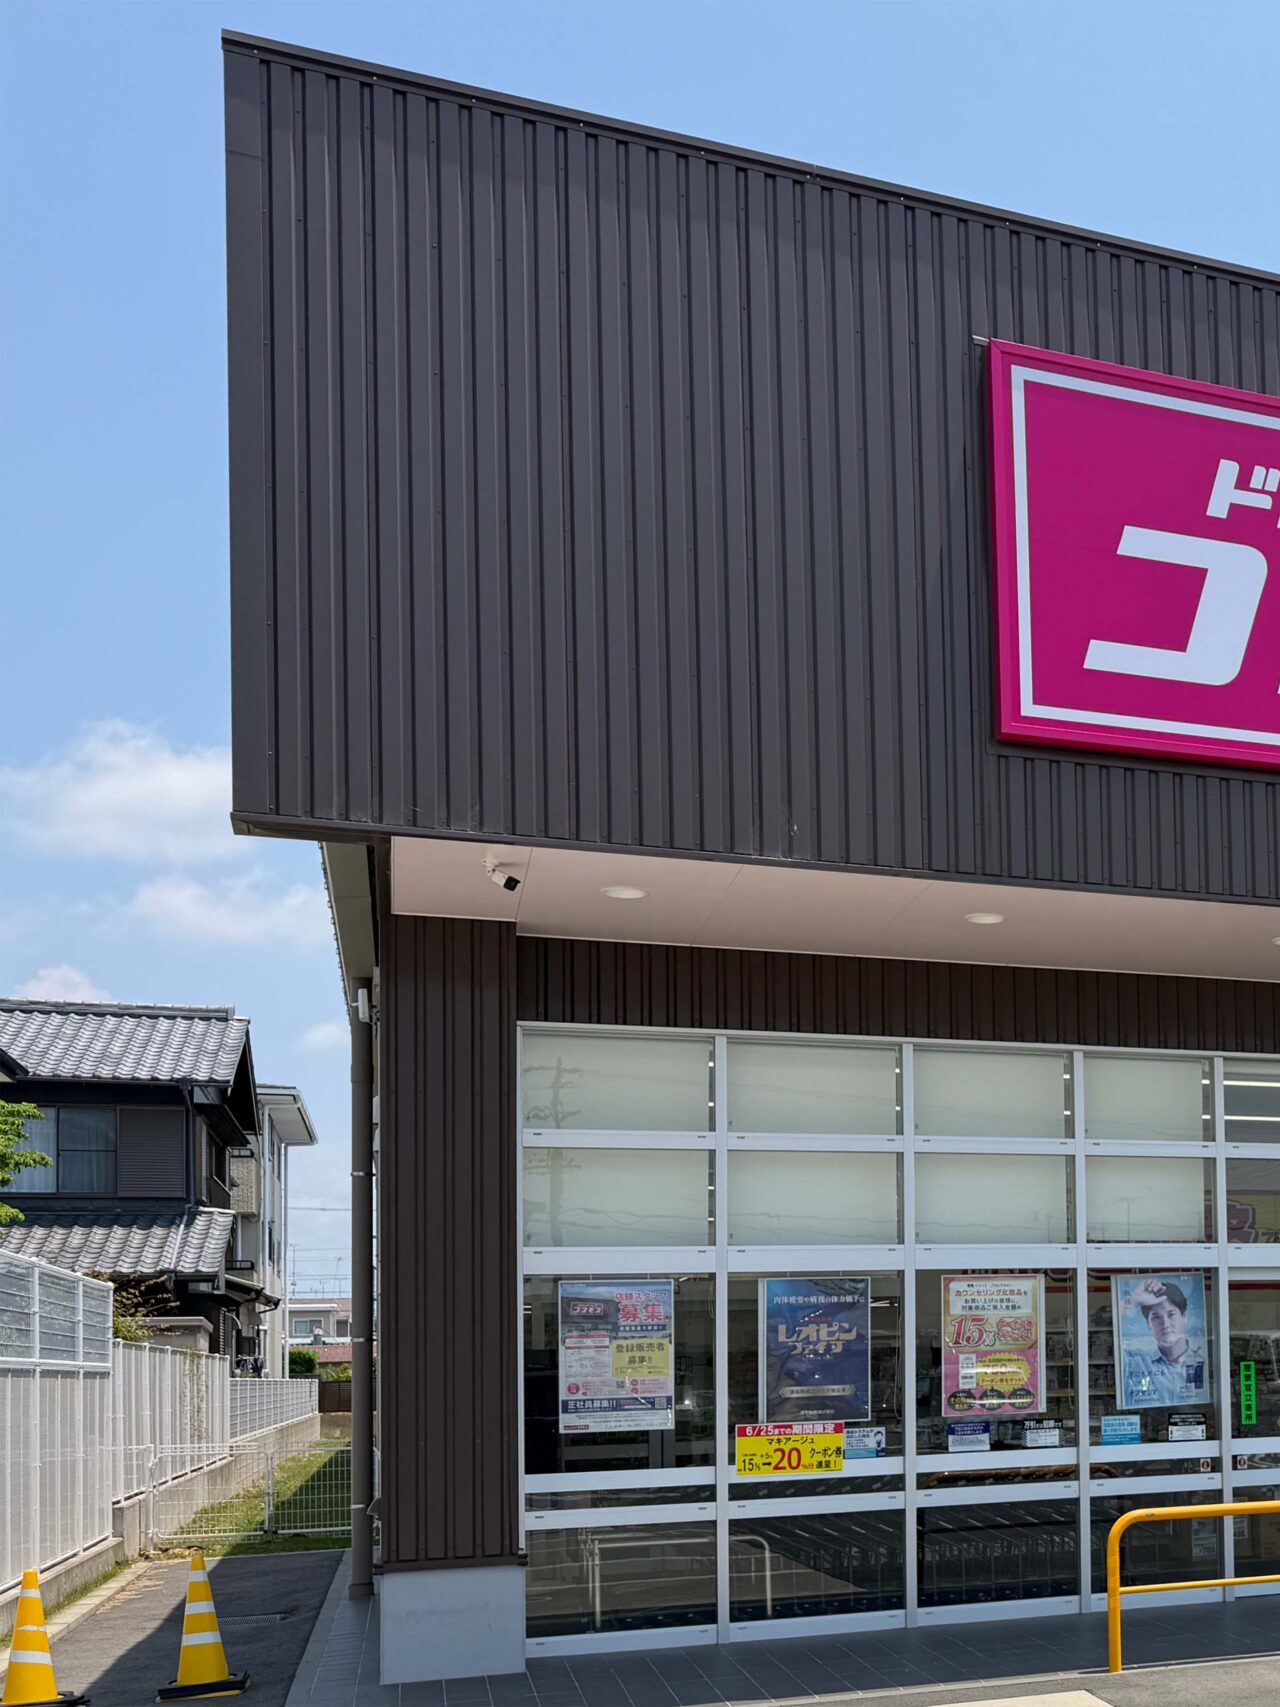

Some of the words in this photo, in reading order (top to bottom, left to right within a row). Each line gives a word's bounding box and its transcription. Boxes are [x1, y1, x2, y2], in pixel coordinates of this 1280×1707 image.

[619, 1303, 663, 1322] 募集
[778, 1322, 857, 1342] レオピン
[615, 1343, 665, 1353] 登録販売者
[745, 1423, 835, 1436] 6/25までの期間限定
[766, 1437, 815, 1446] マキアージュ
[809, 1447, 842, 1458] クーポン券
